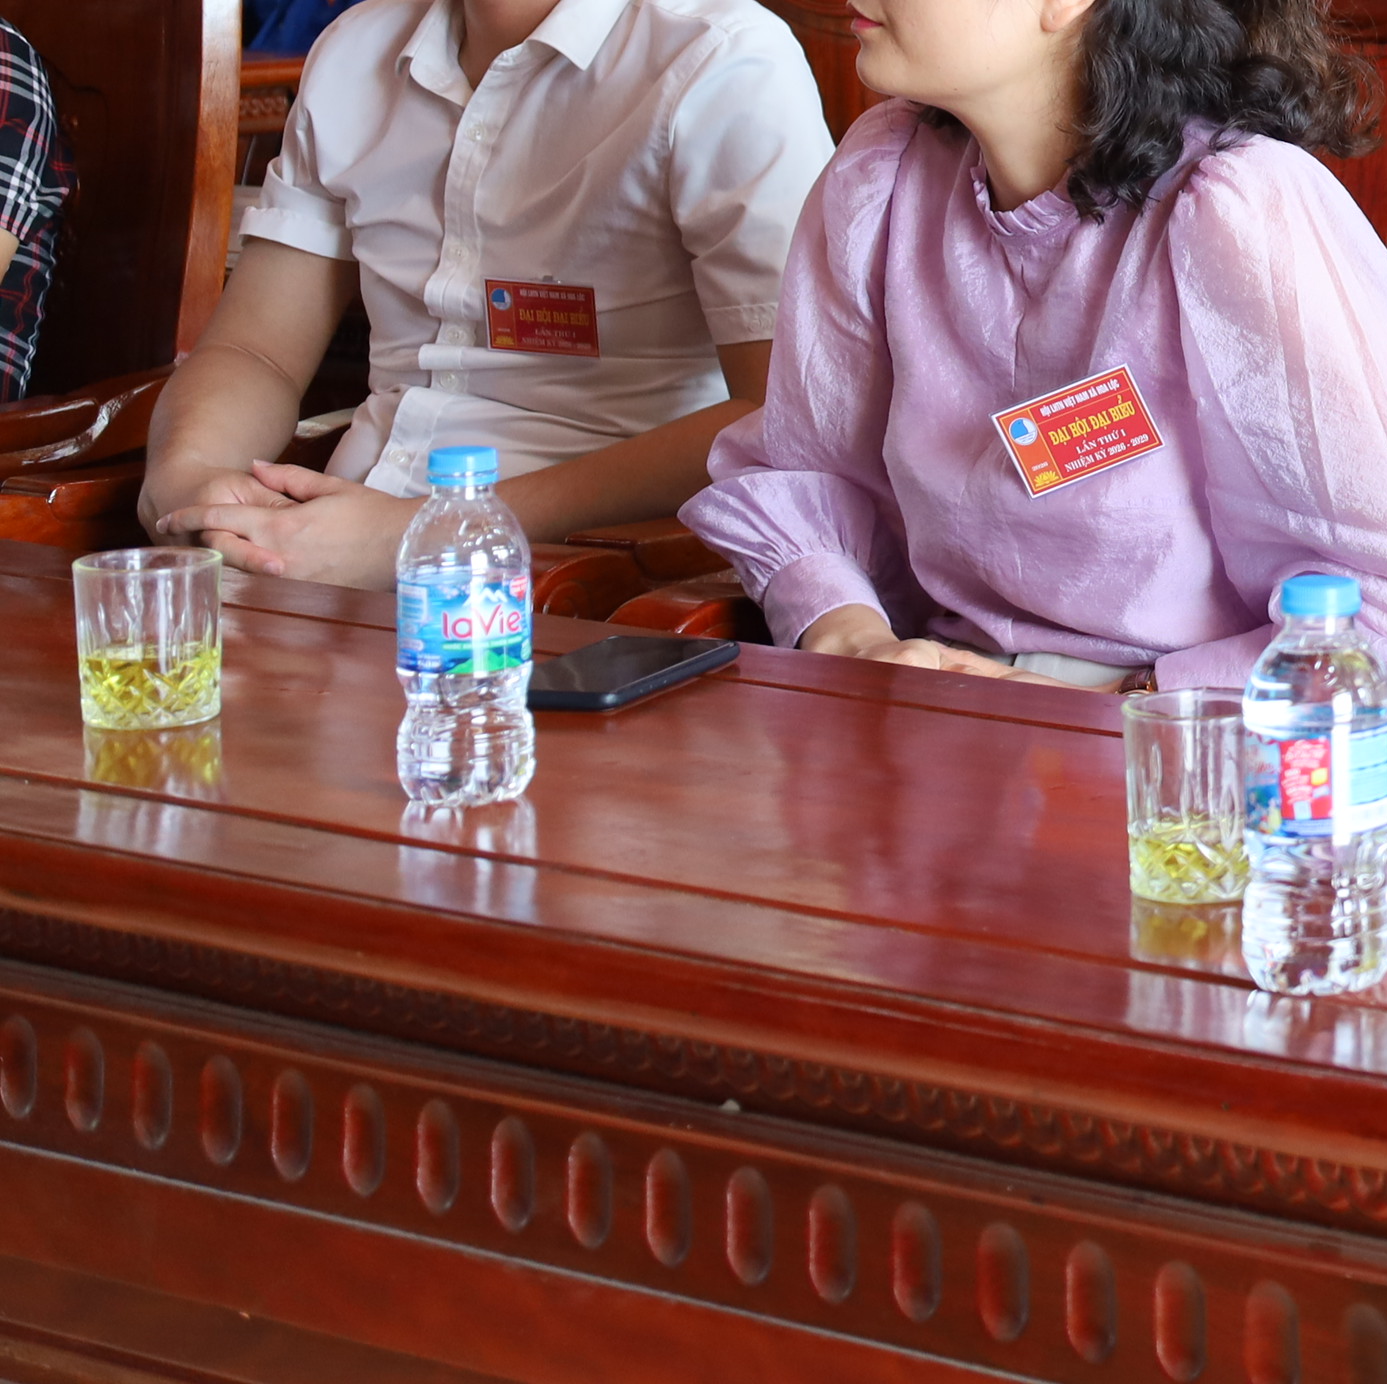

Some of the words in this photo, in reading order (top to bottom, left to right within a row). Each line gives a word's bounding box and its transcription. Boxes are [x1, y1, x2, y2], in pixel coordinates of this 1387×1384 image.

[1062, 396, 1076, 408] VIỆT
[1075, 391, 1090, 404] NAM
[1048, 426, 1071, 446] ĐẠI
[1068, 417, 1091, 437] HỘI
[1088, 411, 1111, 430] ĐẠI
[1108, 395, 1136, 422] BIỂU
[1064, 455, 1094, 472] NHIỆM
[1094, 447, 1109, 461] KỲ
[1107, 443, 1126, 456] 2026
[1131, 434, 1149, 446] 2029
[1076, 440, 1097, 454] LẦN
[1097, 430, 1119, 445] THỨ
[1120, 429, 1126, 437] I
[442, 604, 522, 638] laVie
